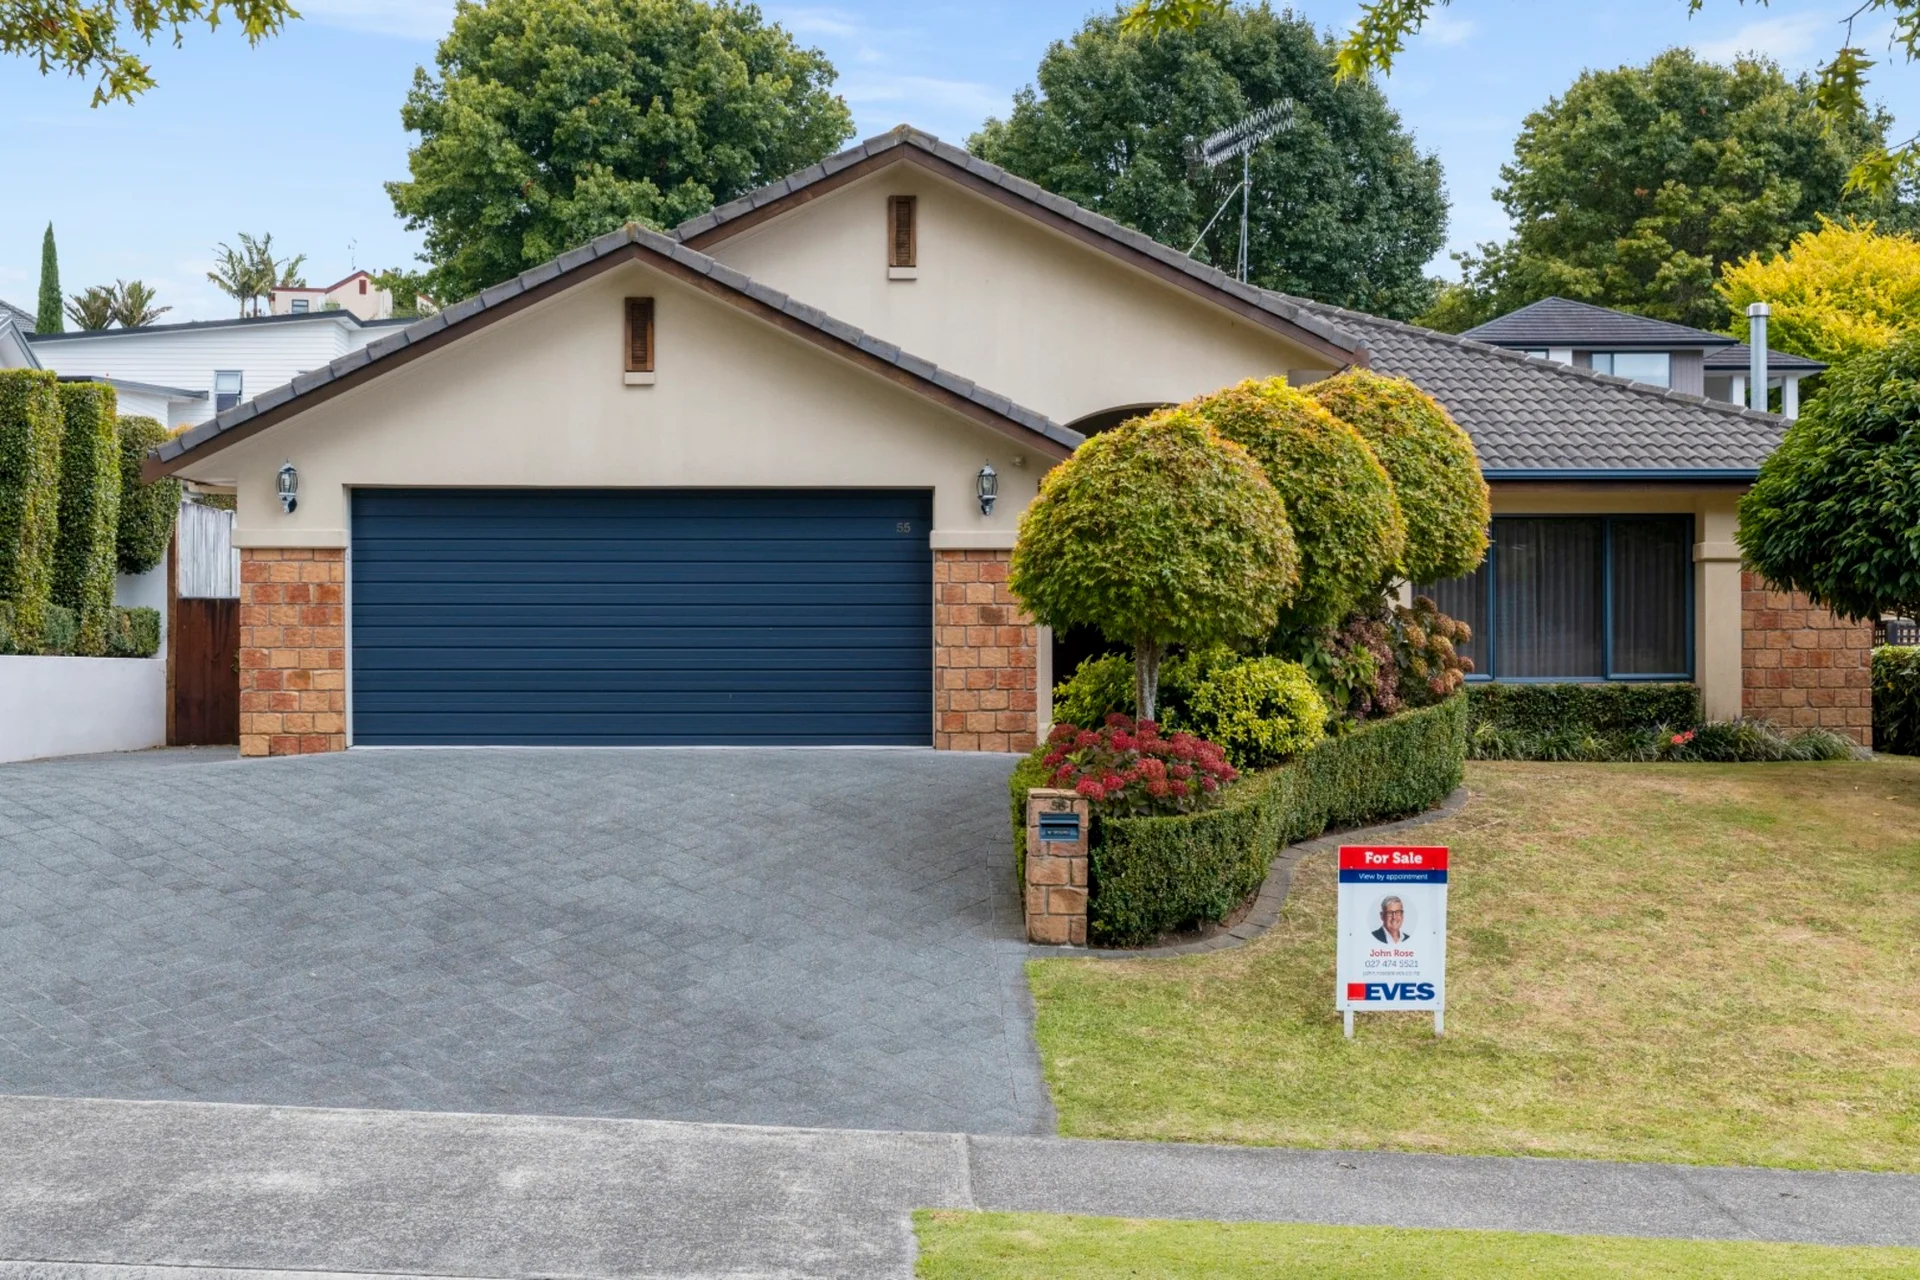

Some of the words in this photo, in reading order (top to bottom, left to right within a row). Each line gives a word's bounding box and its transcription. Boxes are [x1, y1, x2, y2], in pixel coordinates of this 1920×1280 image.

[896, 522, 911, 533] 55
[1364, 851, 1389, 864] For
[1392, 851, 1423, 864] Sale
[1376, 873, 1385, 881] by
[1386, 873, 1428, 881] appointment
[1369, 949, 1392, 957] John
[1394, 949, 1415, 957] Rose
[1364, 960, 1380, 968] 027
[1382, 960, 1397, 968] 474
[1399, 960, 1418, 968] 5521
[1366, 982, 1435, 1001] EVES
